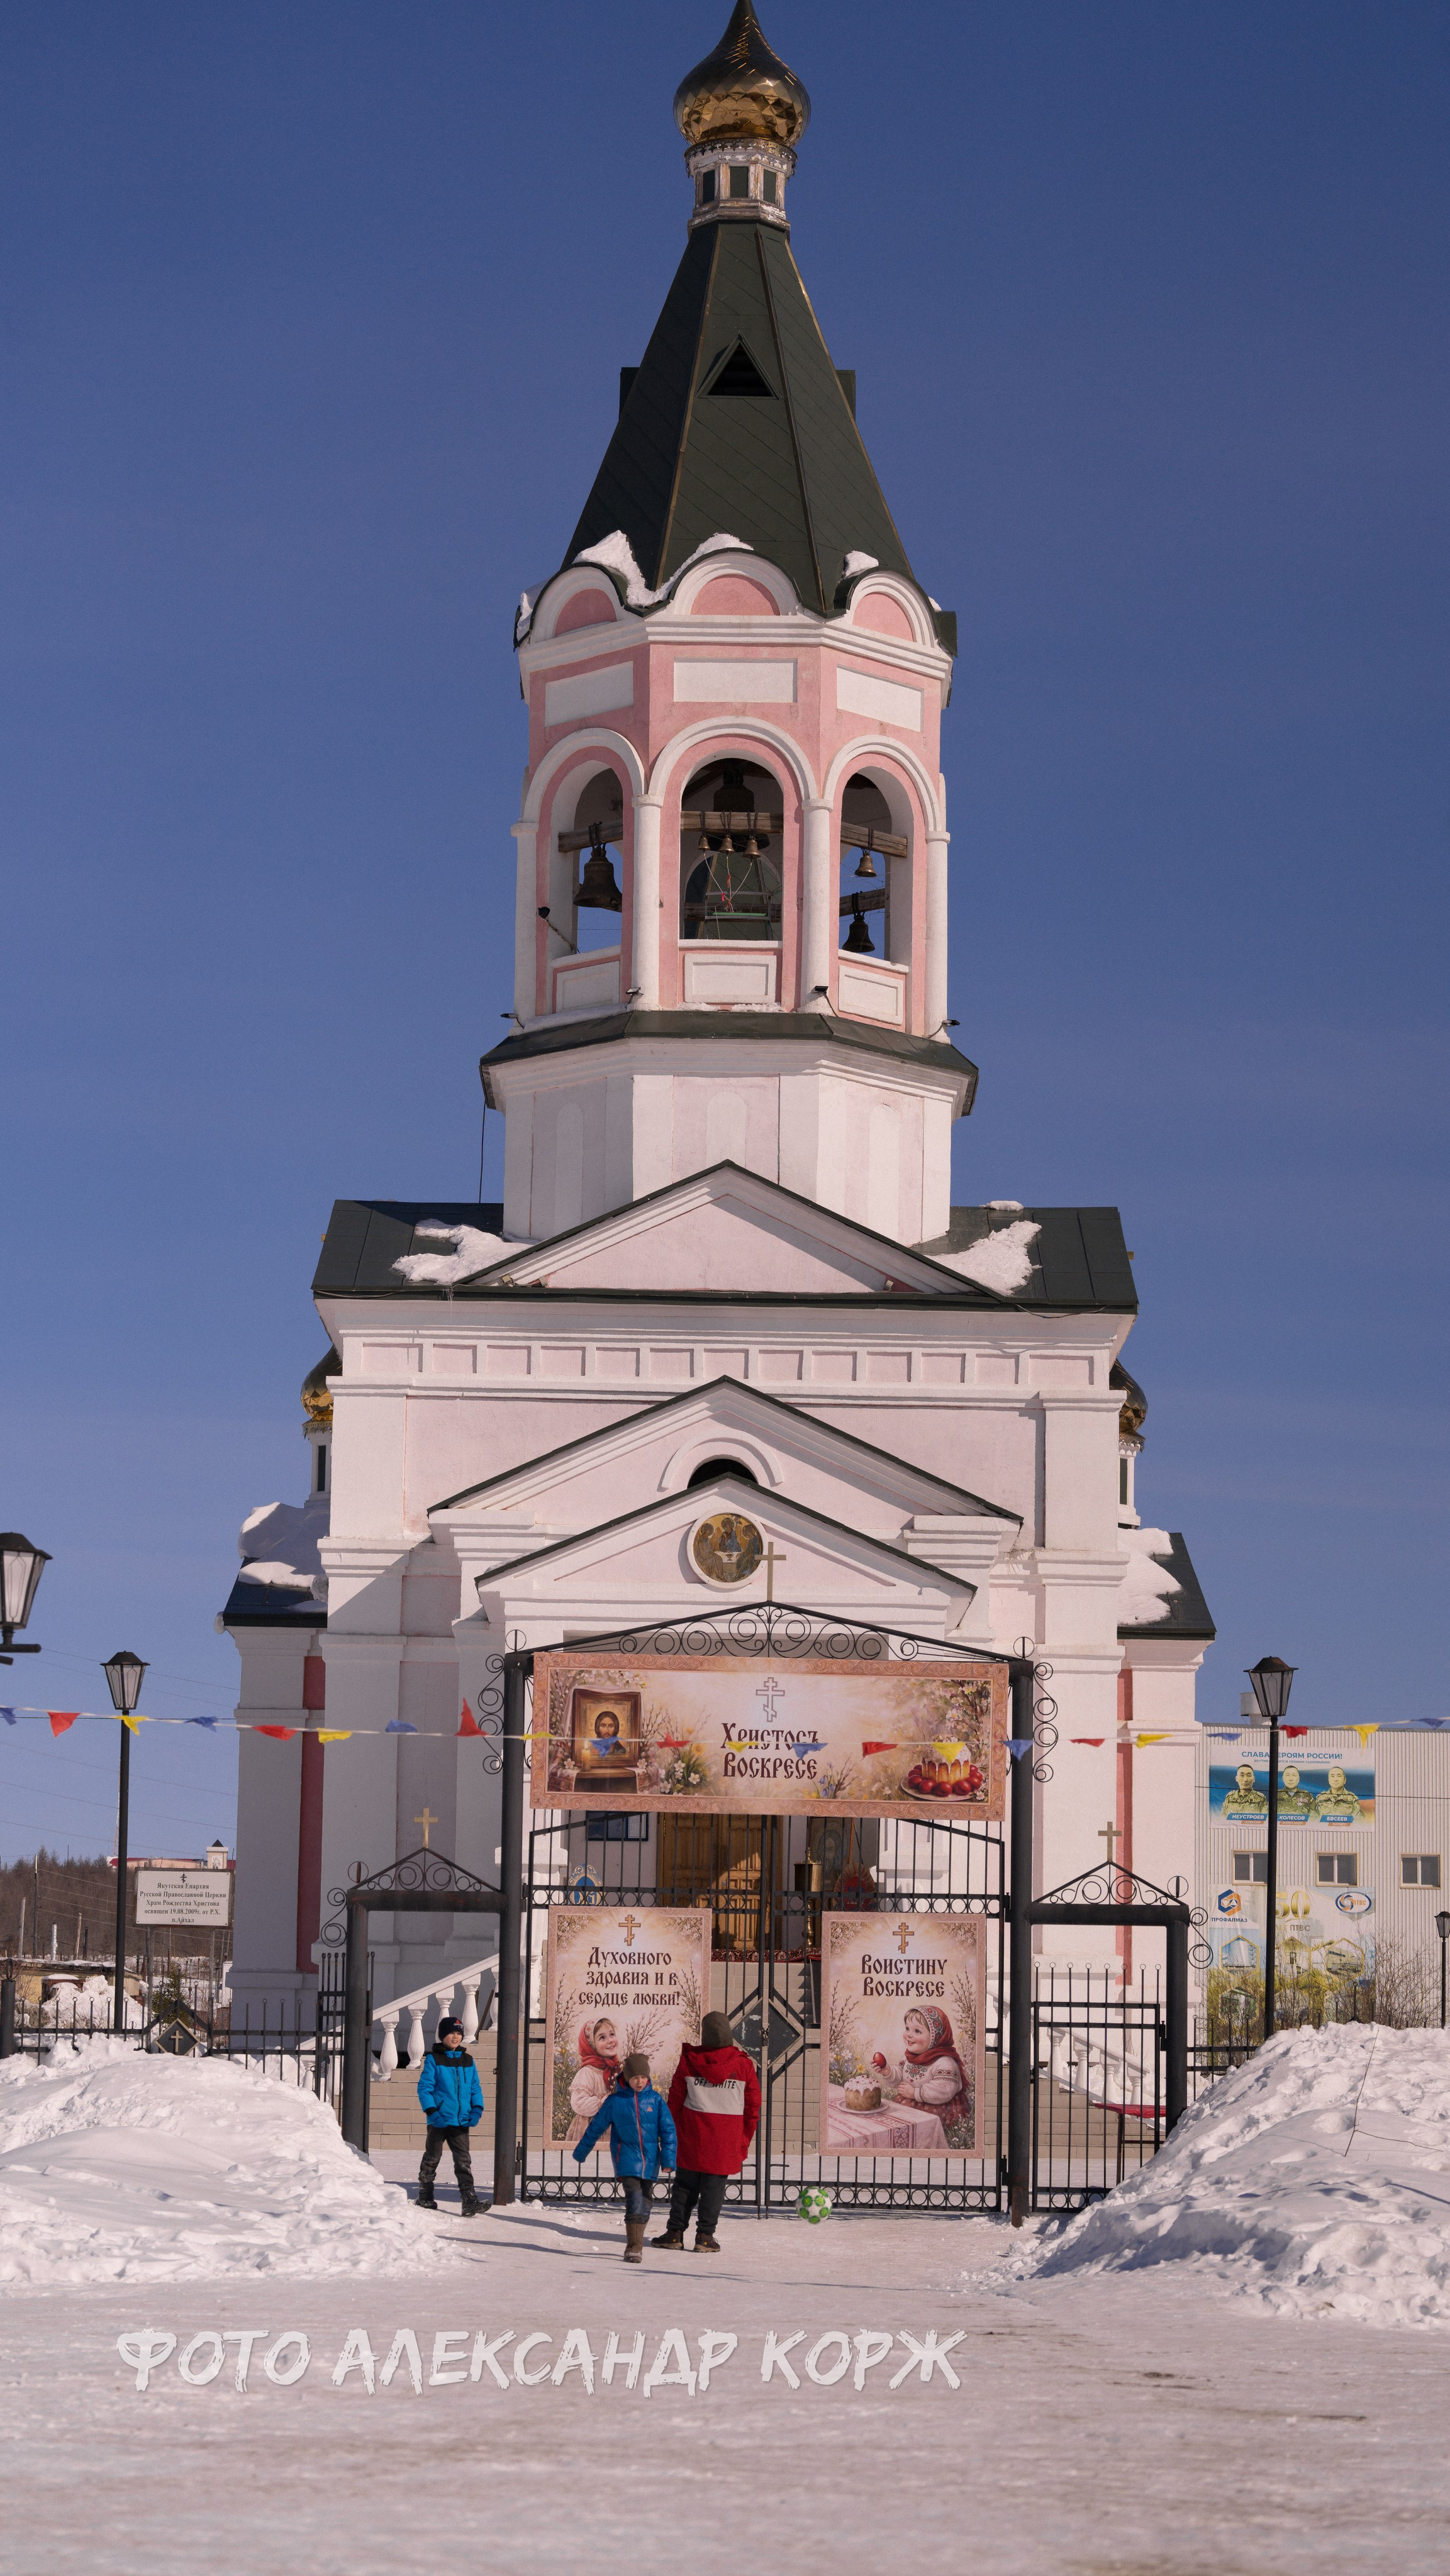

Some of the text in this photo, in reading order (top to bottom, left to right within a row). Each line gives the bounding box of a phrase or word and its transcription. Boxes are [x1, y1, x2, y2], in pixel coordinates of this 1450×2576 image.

[588, 1946, 672, 1968] Духовного
[655, 1972, 664, 1985] и
[579, 1992, 628, 2008] сердце
